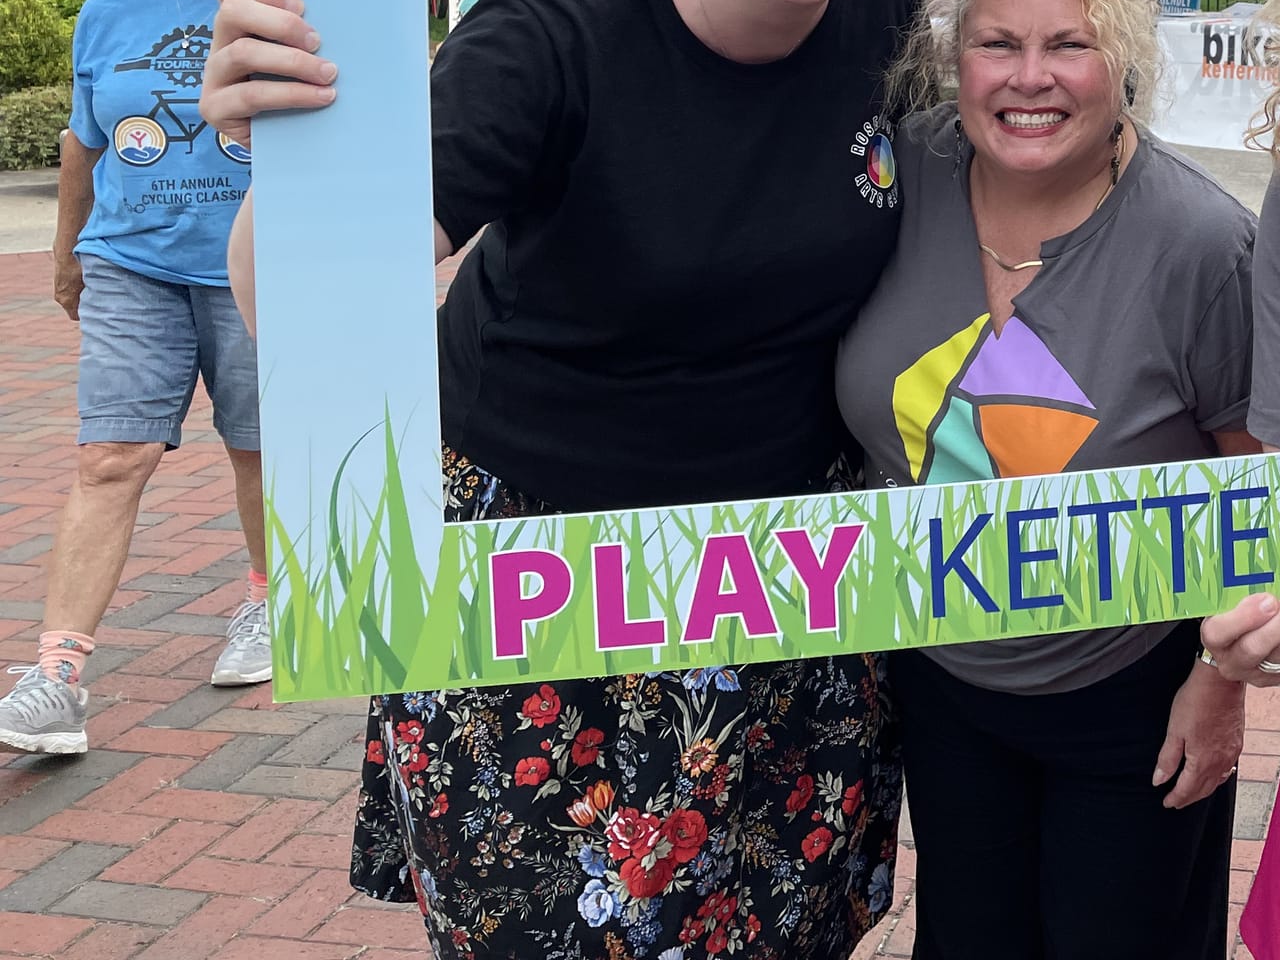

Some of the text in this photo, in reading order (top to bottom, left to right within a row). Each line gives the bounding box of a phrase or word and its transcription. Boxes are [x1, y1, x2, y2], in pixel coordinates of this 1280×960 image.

[151, 176, 232, 191] 6TH ANNUAL
[854, 173, 884, 208] ARTS
[141, 192, 193, 205] CYCLING
[488, 522, 868, 660] PLAY
